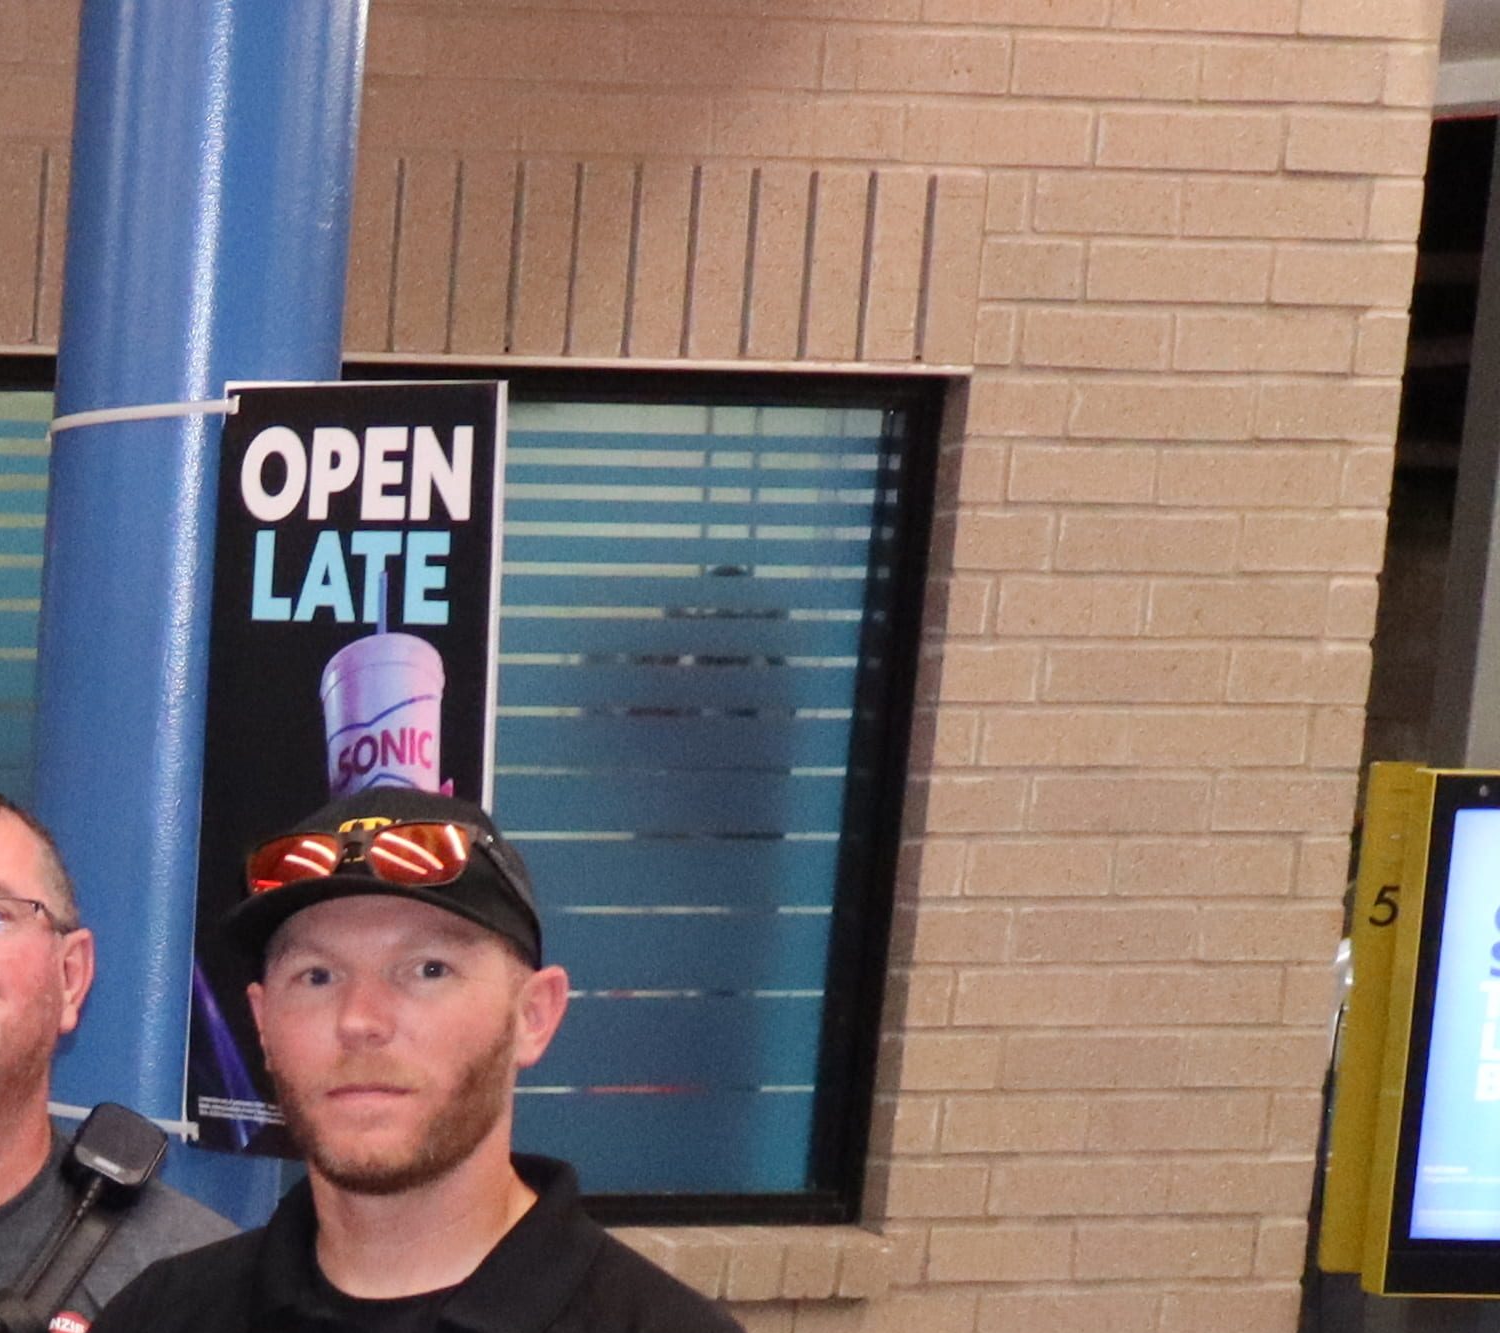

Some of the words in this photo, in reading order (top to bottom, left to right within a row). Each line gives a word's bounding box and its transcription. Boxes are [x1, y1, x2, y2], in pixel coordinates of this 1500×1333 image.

[240, 425, 475, 522] OPEN
[251, 530, 452, 626] LATE
[337, 727, 433, 779] SONIC
[1369, 885, 1400, 927] 5
